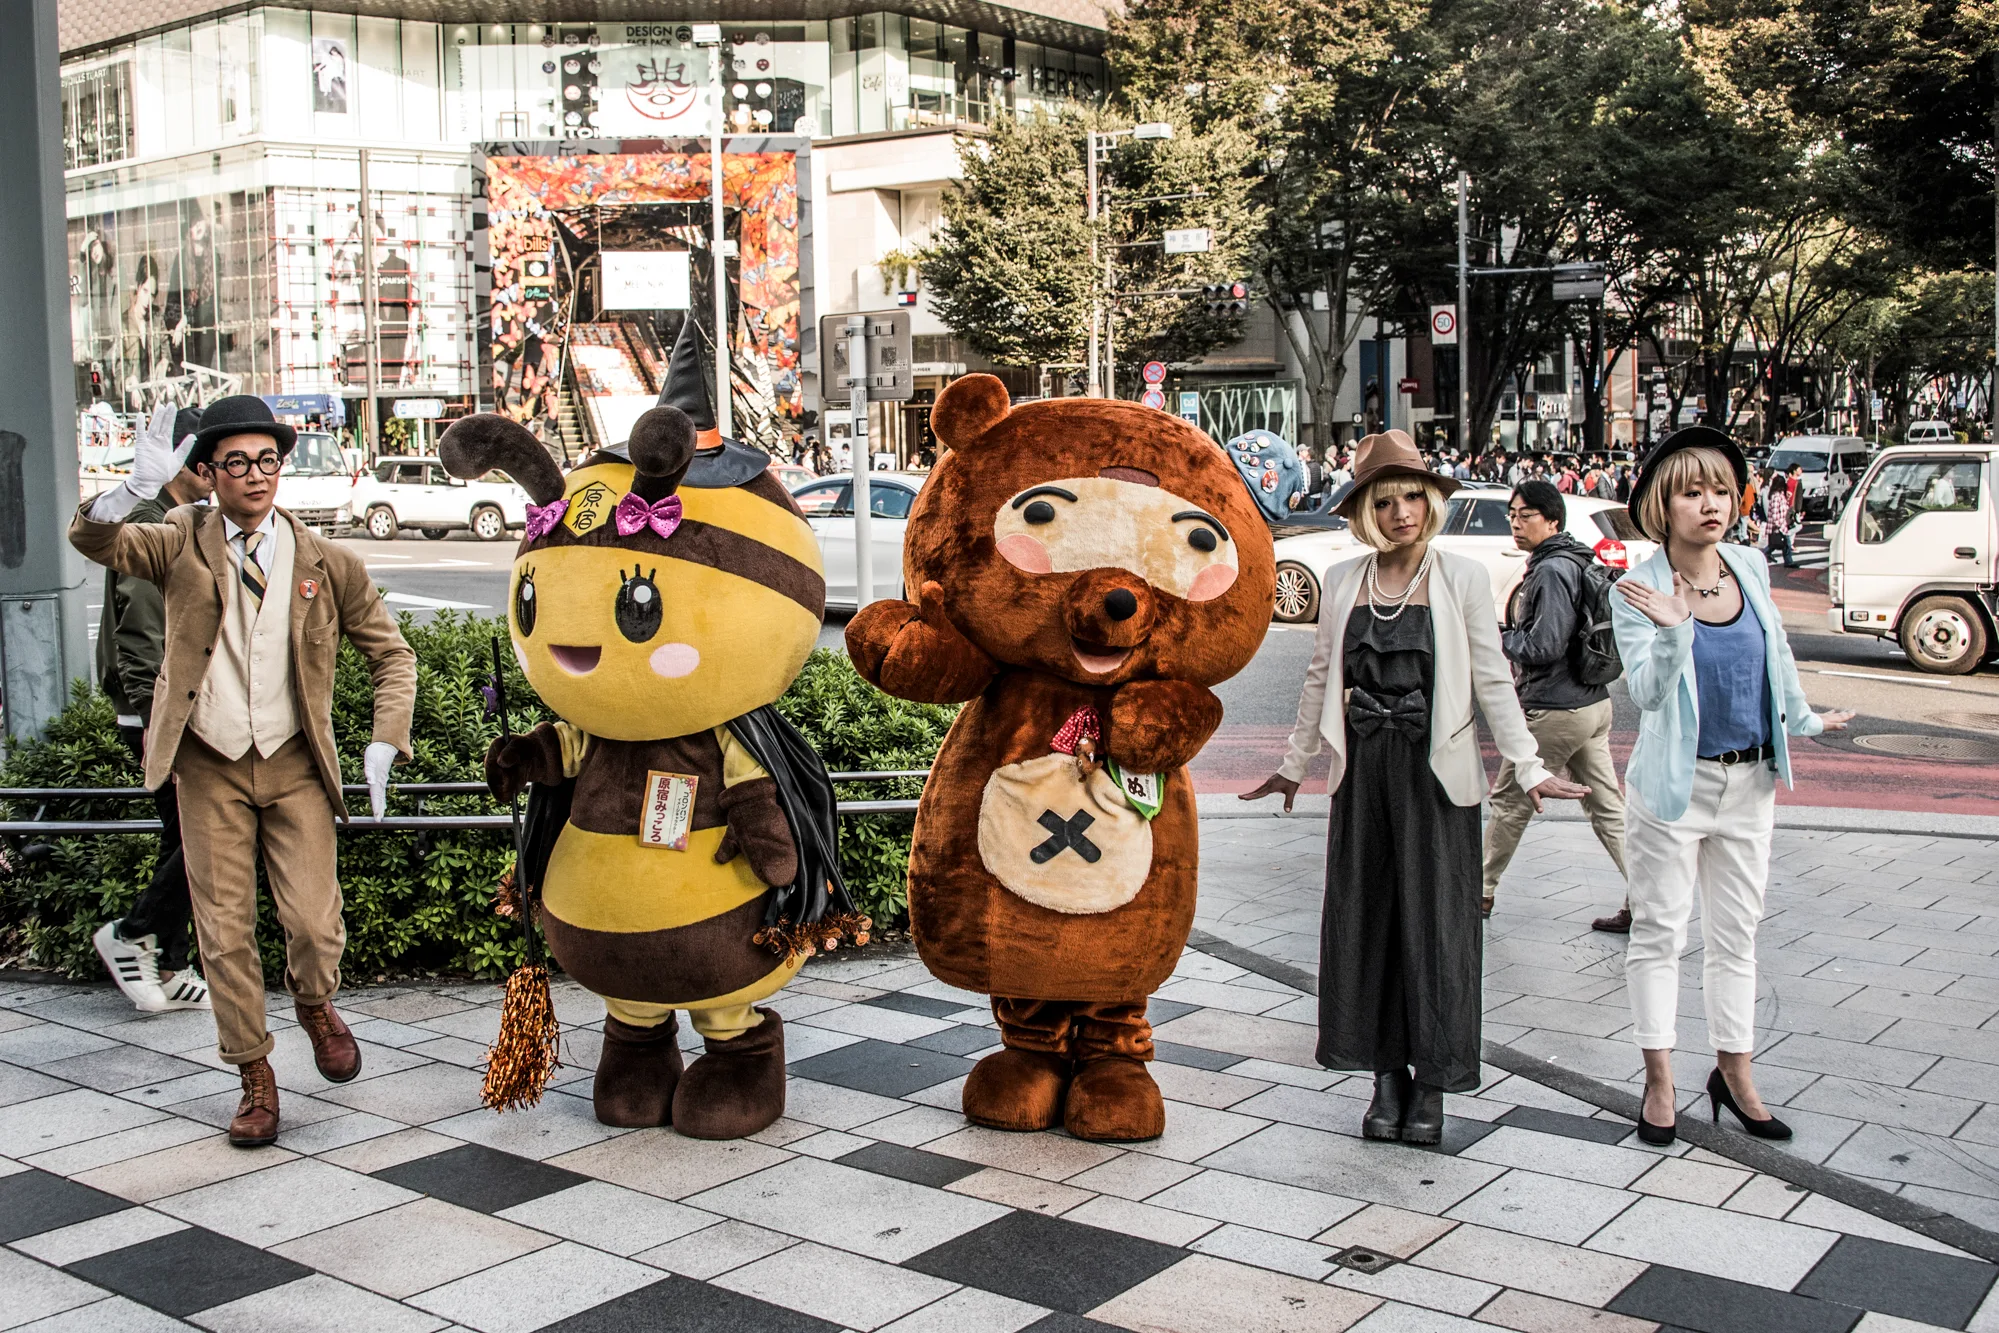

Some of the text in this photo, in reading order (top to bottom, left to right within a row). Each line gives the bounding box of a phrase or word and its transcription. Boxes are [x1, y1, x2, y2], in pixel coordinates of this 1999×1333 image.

[626, 25, 673, 37] DESIGN
[627, 38, 672, 47] FACE PACK
[524, 236, 548, 251] bills
[1437, 317, 1451, 328] 50
[572, 488, 606, 530] 原宿
